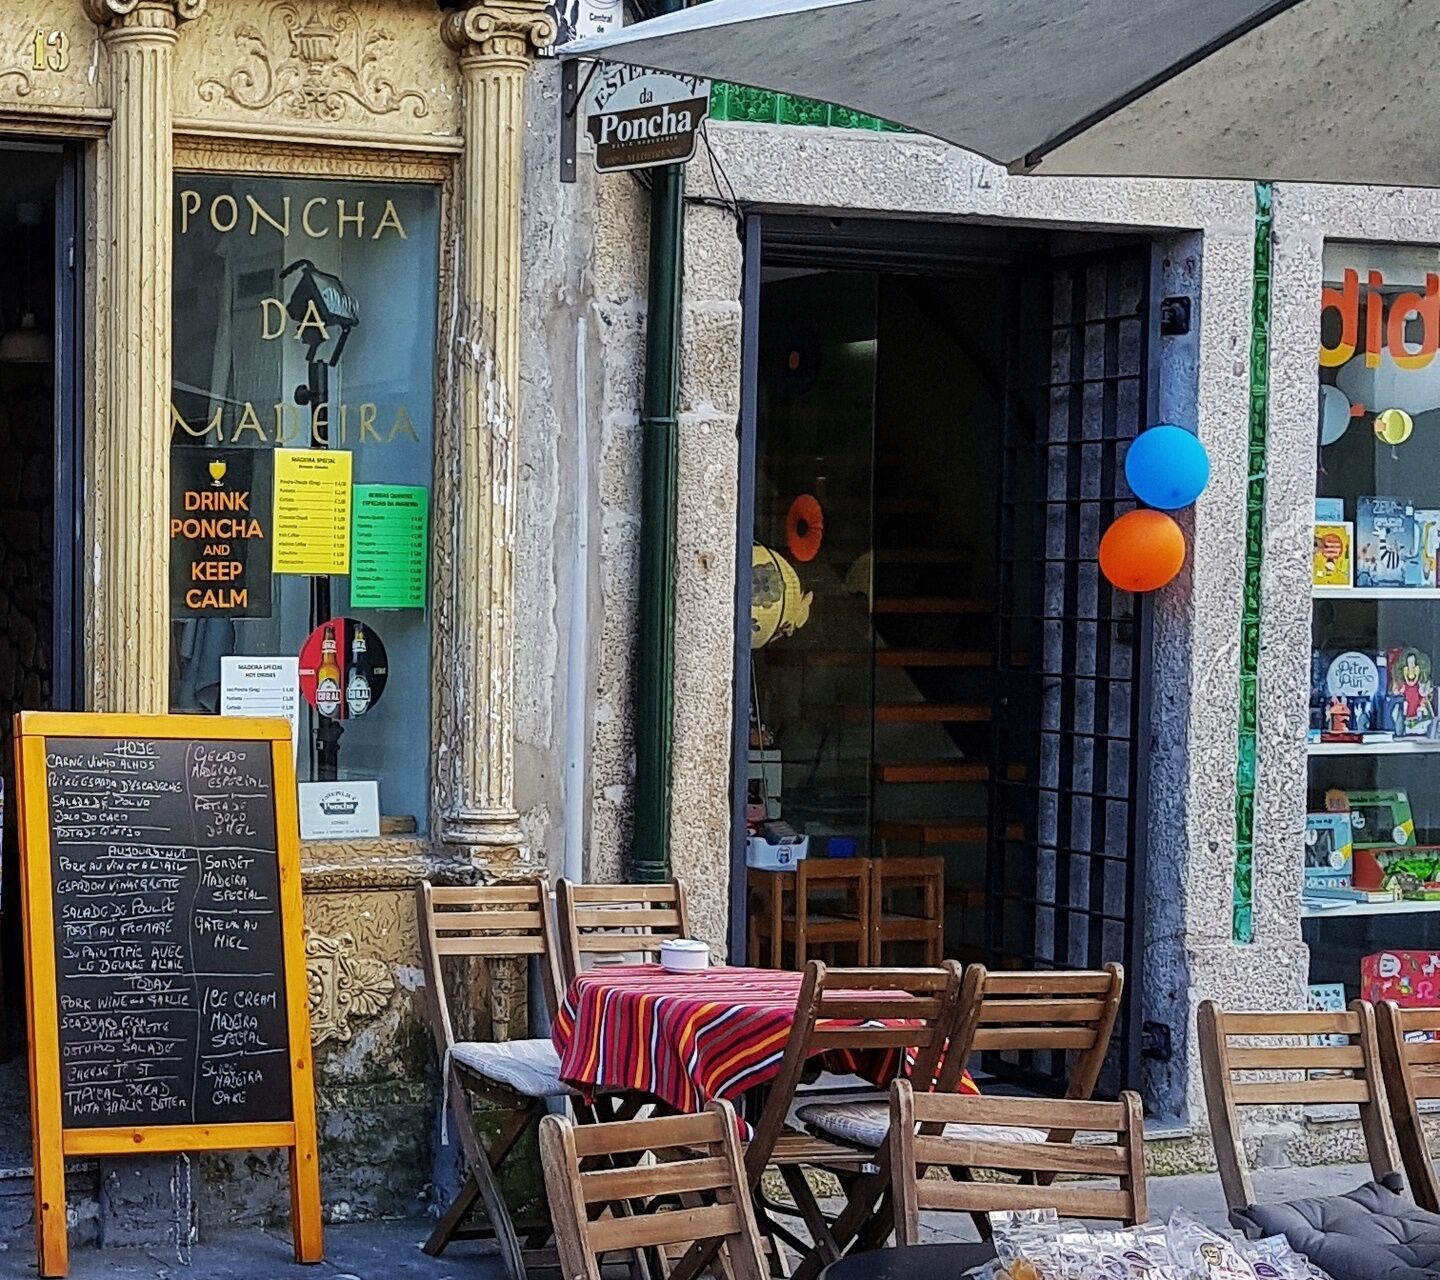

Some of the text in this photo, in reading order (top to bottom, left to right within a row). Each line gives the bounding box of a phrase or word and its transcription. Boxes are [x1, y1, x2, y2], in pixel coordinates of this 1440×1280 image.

[31, 29, 71, 72] 13
[639, 87, 653, 105] da
[598, 105, 692, 145] Poncha
[180, 190, 408, 240] PONCHA
[261, 297, 331, 340] DA
[171, 401, 420, 444] MADEIRA
[185, 491, 249, 511] DRINK
[170, 518, 264, 539] PONCHA
[203, 544, 230, 556] AND
[191, 561, 242, 580] KEEP
[186, 589, 248, 609] CALM
[1336, 660, 1369, 676] Peter
[114, 740, 155, 756] HOJE
[194, 746, 246, 762] GELADO
[46, 754, 83, 768] CARNE
[120, 759, 155, 770] ALHOS
[208, 774, 269, 788] ESPECIAL
[214, 812, 246, 825] BOLO
[89, 862, 102, 871] AU
[107, 859, 124, 870] VIN
[202, 871, 247, 887] MADEIRA
[212, 887, 268, 901] SPECIAL
[62, 903, 108, 918] SALADE
[100, 926, 115, 936] AU
[120, 919, 173, 936] FROMAGE
[244, 920, 258, 932] AU
[214, 934, 249, 950] MIEL
[82, 945, 107, 959] PAIN
[123, 976, 173, 991] TODAY
[61, 995, 91, 1010] PORK
[98, 995, 128, 1008] WINE
[147, 995, 190, 1007] GARLIC
[203, 987, 276, 1015] ICE CREAM
[126, 1081, 170, 1096] BREAD
[212, 1090, 247, 1105] CAKE
